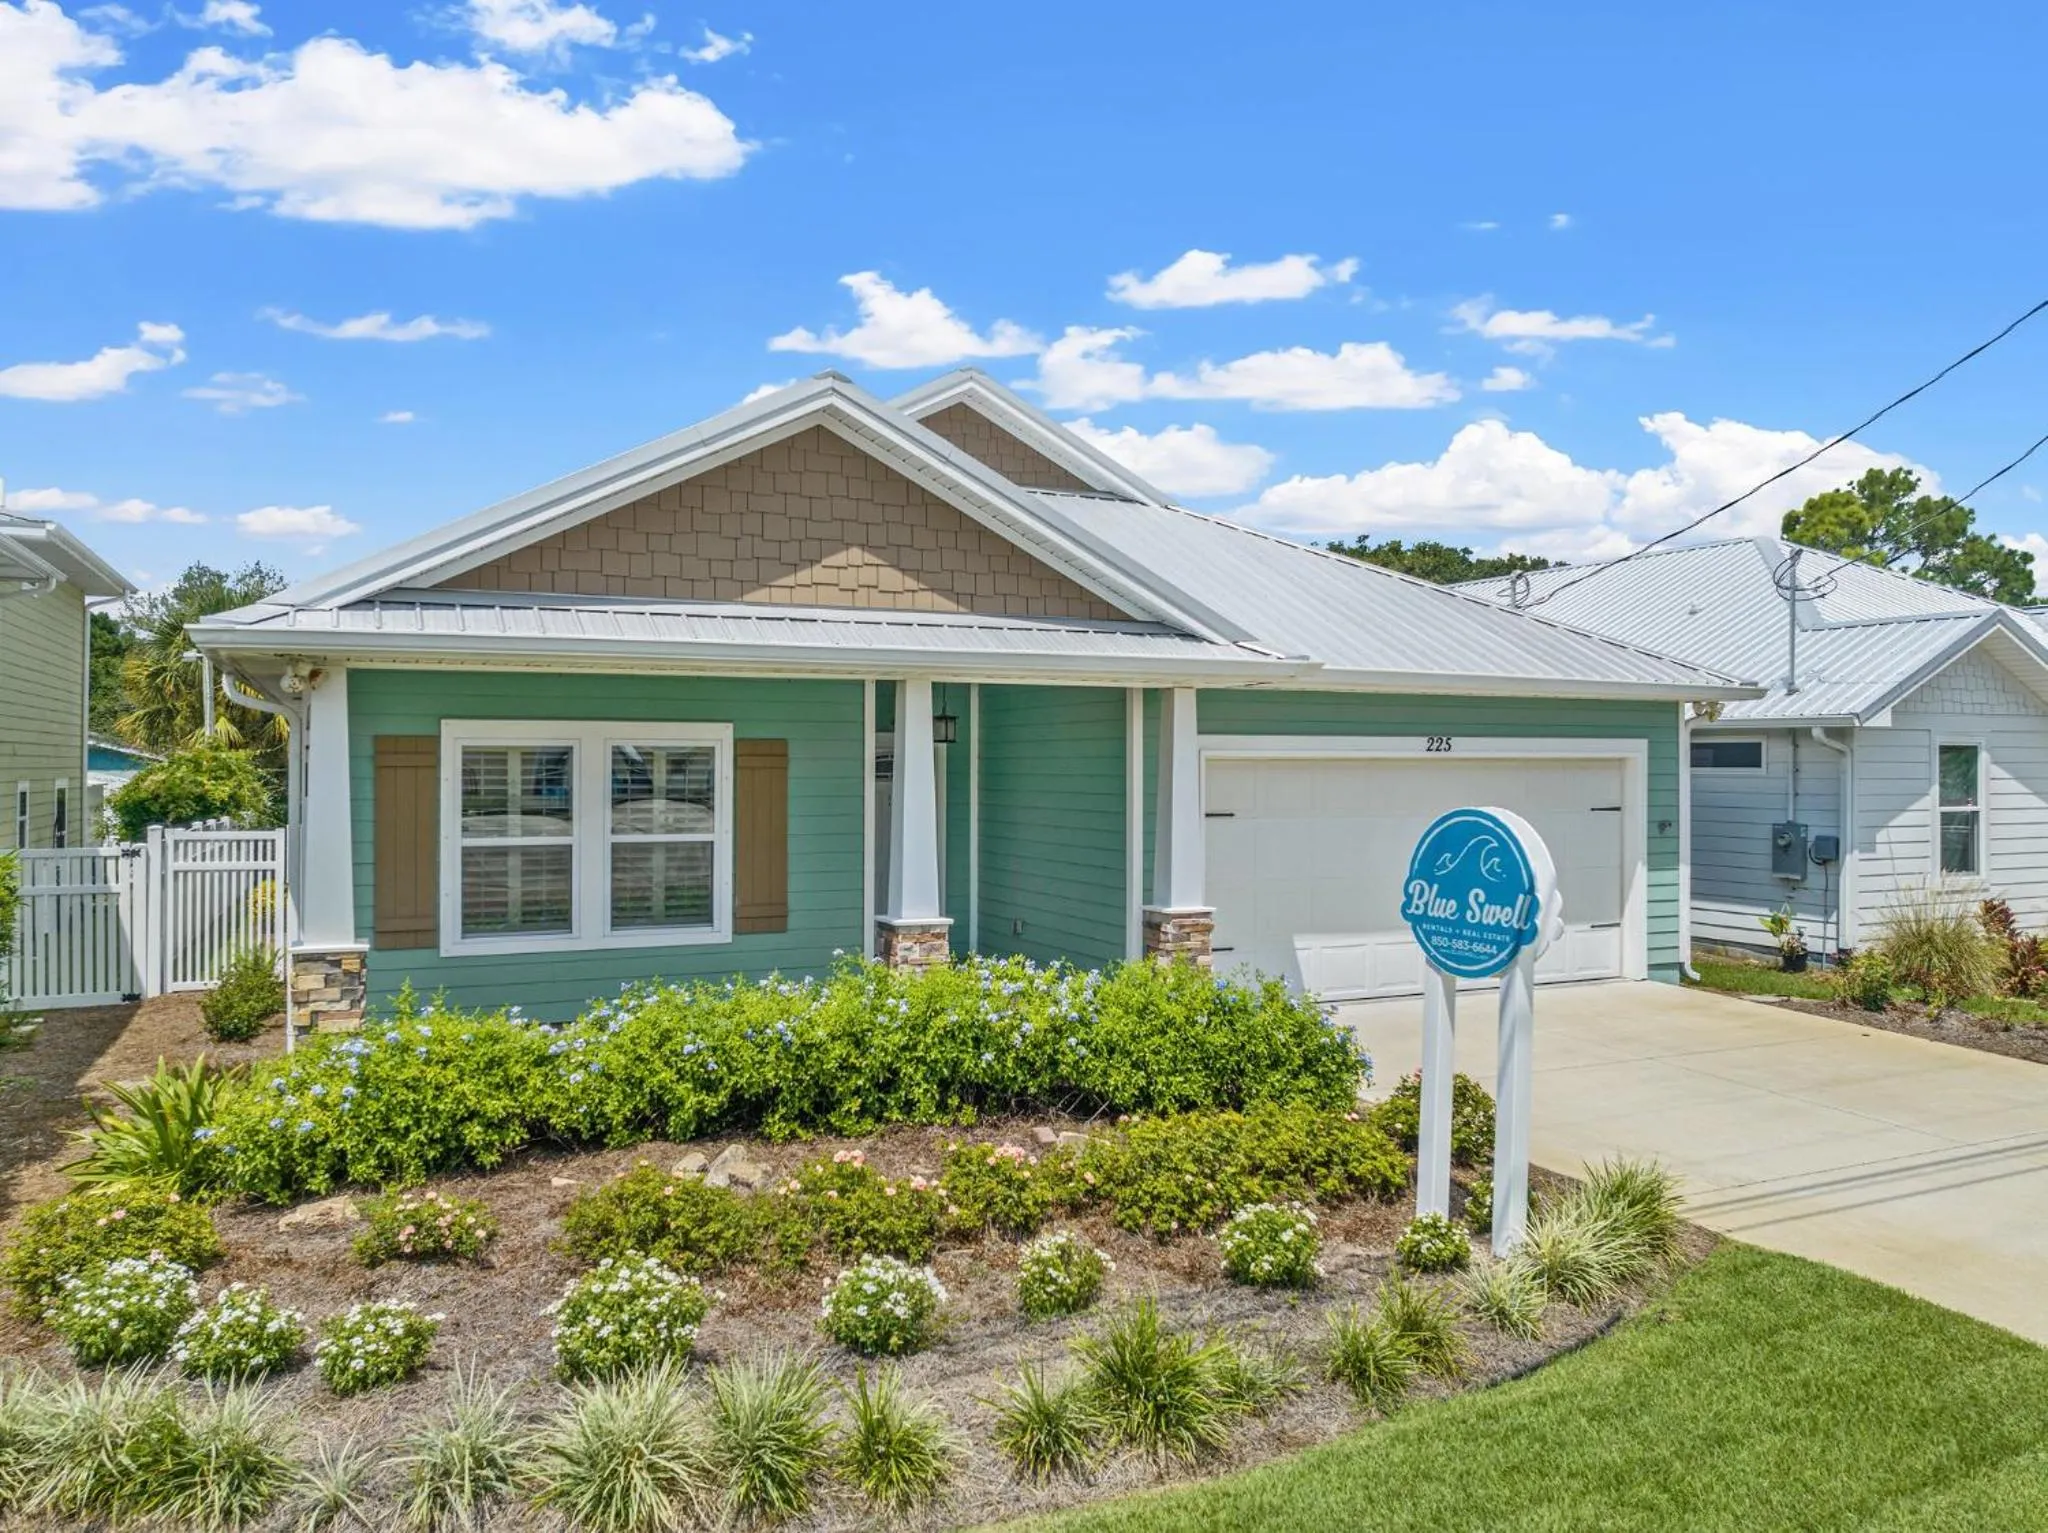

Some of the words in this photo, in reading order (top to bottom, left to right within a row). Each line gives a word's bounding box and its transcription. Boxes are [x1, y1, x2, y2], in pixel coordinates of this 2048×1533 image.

[1426, 736, 1452, 752] 225
[1405, 879, 1459, 920] Blue
[1466, 888, 1531, 930] Swell
[1422, 923, 1453, 934] RENTALS
[1462, 929, 1480, 938] REAL
[1483, 932, 1511, 943] ESTATE
